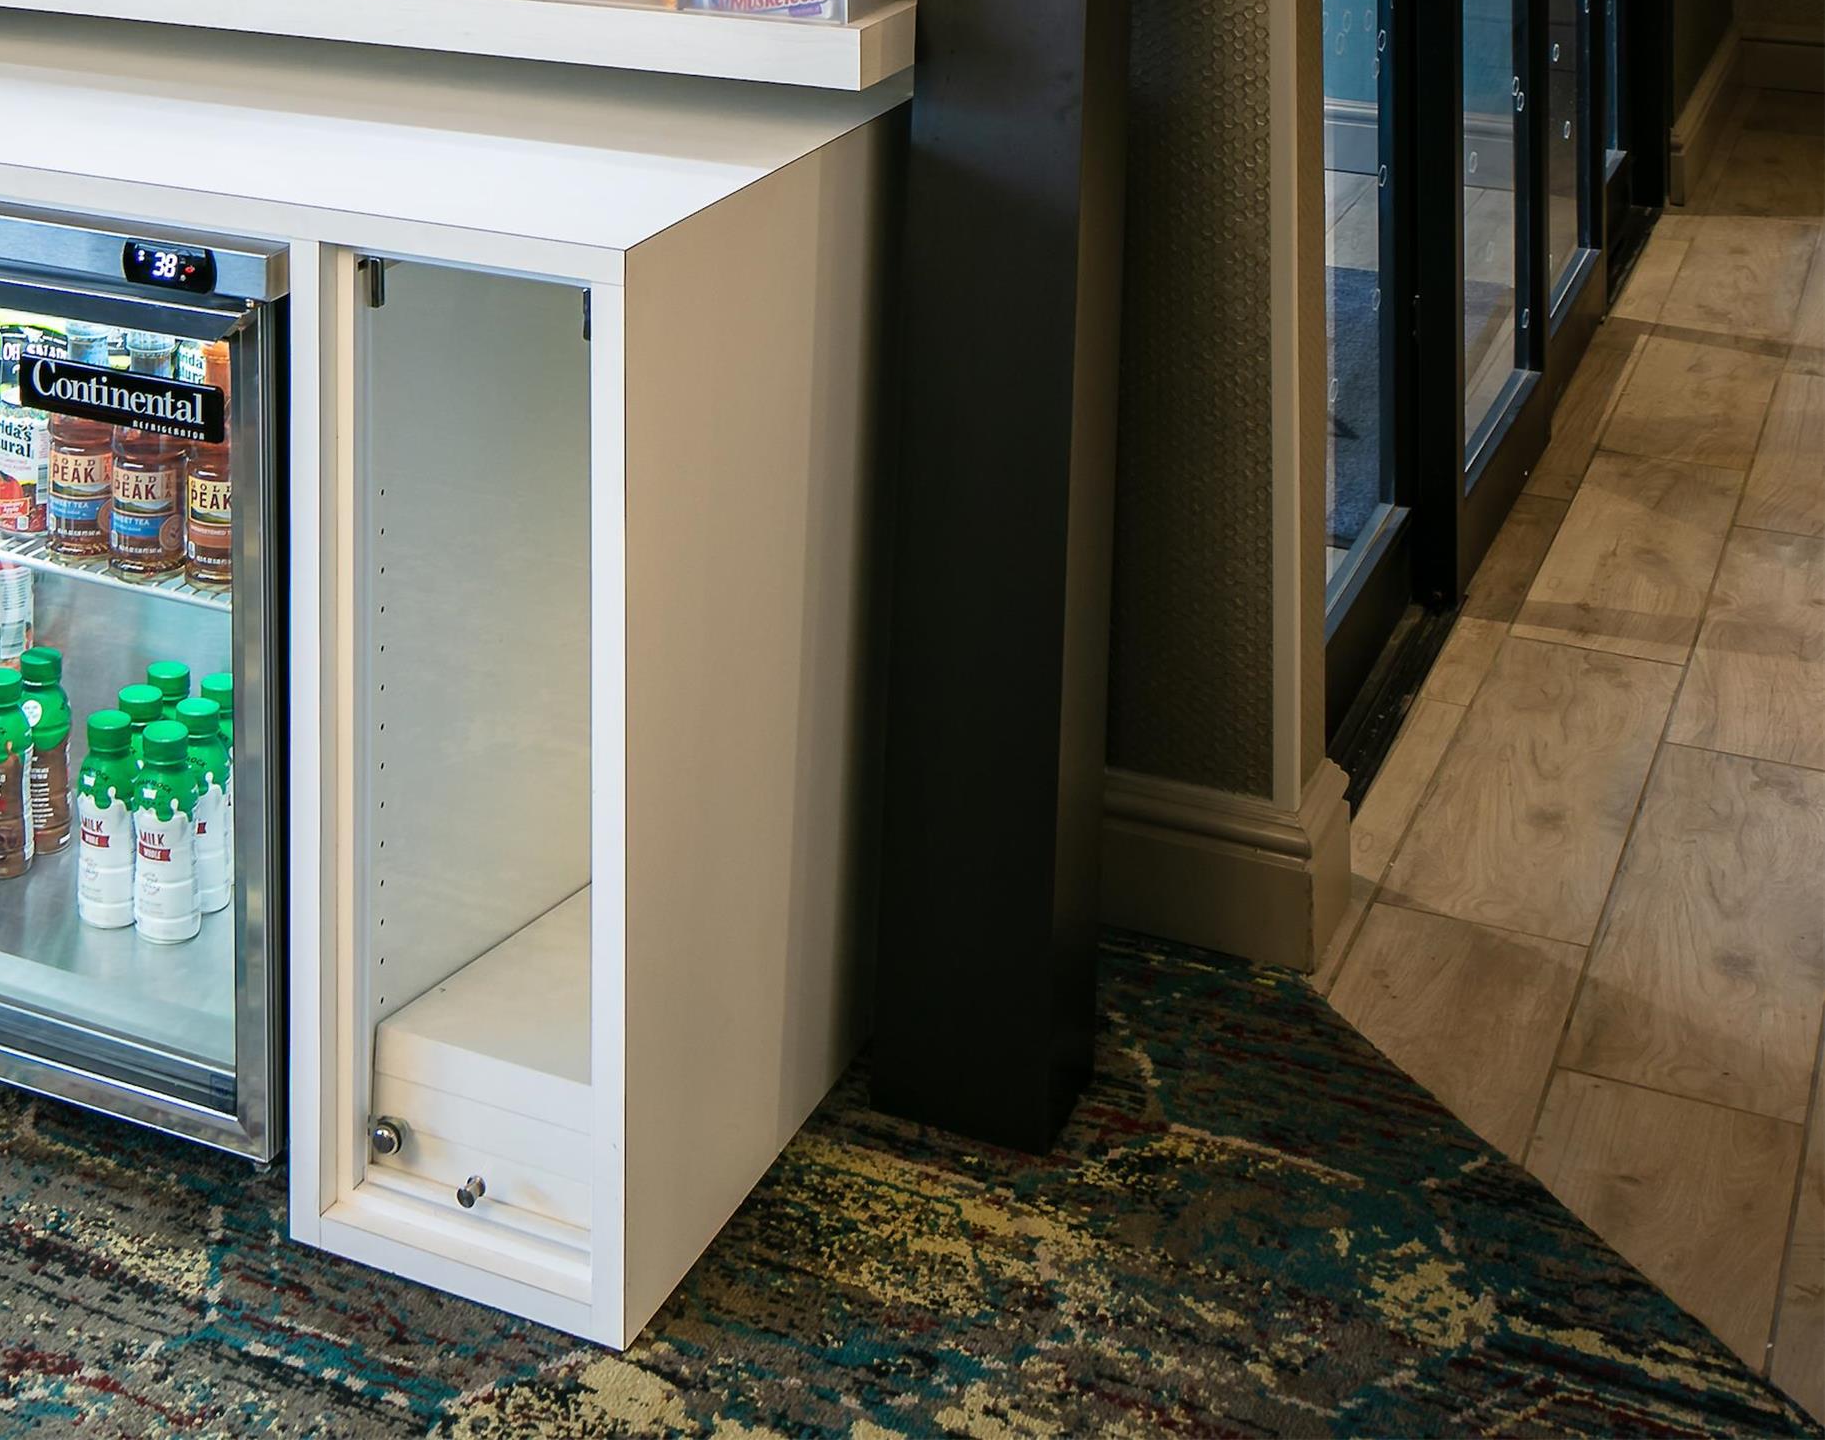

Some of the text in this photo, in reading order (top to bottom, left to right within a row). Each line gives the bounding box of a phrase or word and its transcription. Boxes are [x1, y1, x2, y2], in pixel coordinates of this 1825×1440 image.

[152, 251, 178, 278] 38
[32, 359, 205, 425] Continental
[132, 420, 205, 440] REFRIGERATOR
[52, 465, 95, 483] PEAK
[115, 480, 157, 500] PEAK
[81, 816, 103, 833] MILK
[139, 830, 165, 847] MILK
